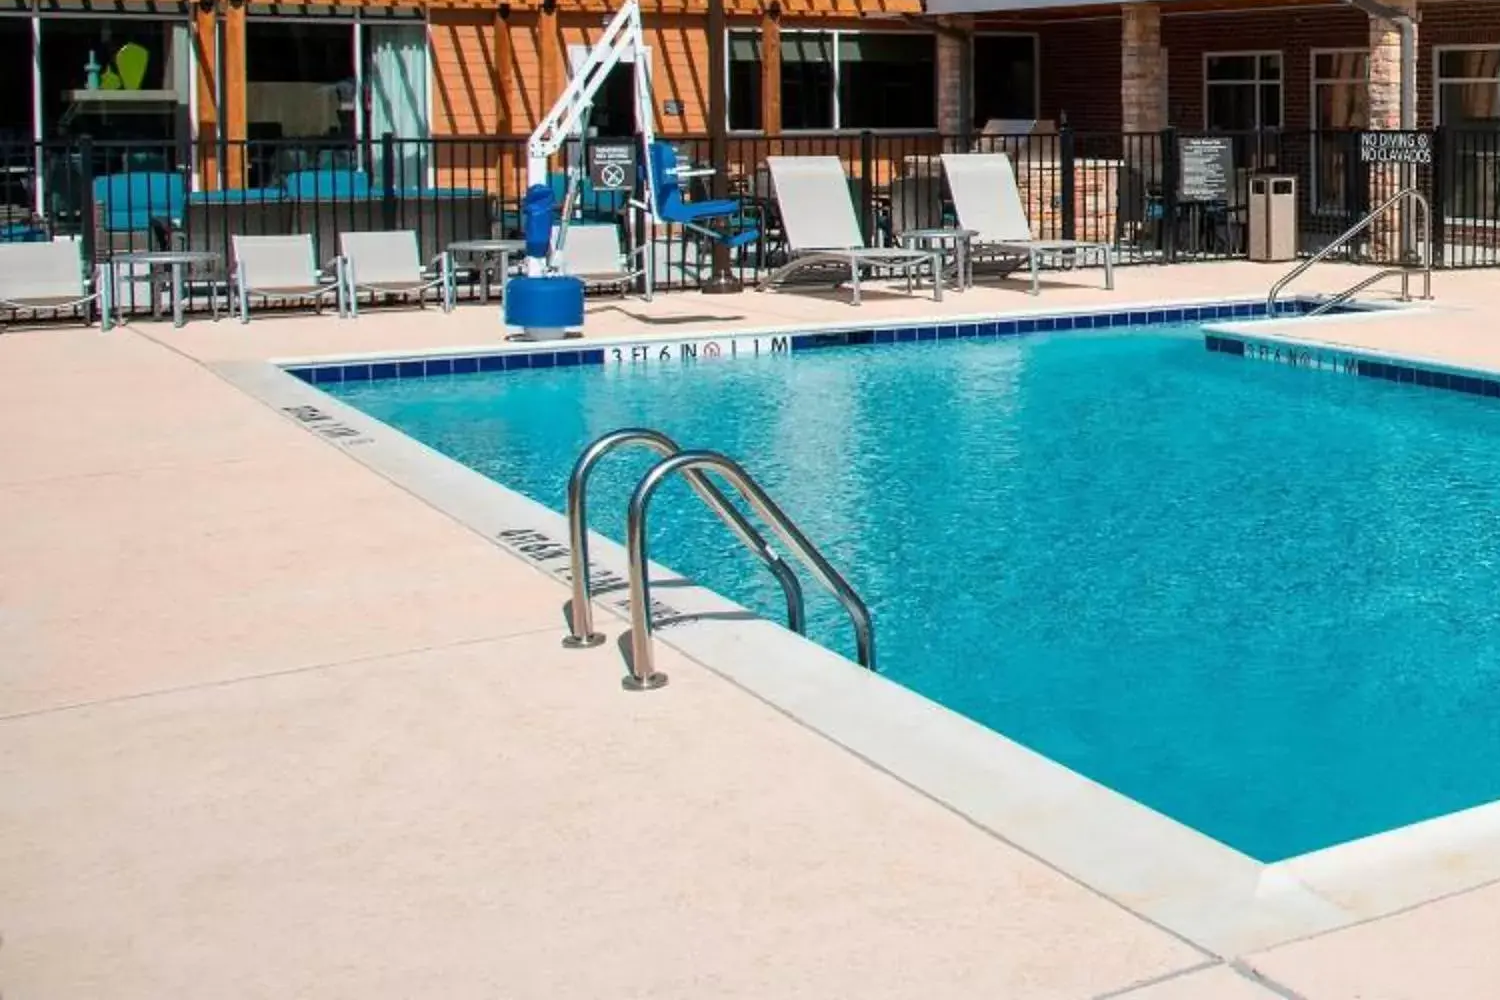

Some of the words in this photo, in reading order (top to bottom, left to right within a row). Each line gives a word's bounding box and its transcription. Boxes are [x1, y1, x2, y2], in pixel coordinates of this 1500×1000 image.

[1361, 133, 1377, 146] NO
[1379, 133, 1416, 147] DIVING
[1361, 147, 1377, 161] NO
[1378, 148, 1431, 162] CLAVADOS
